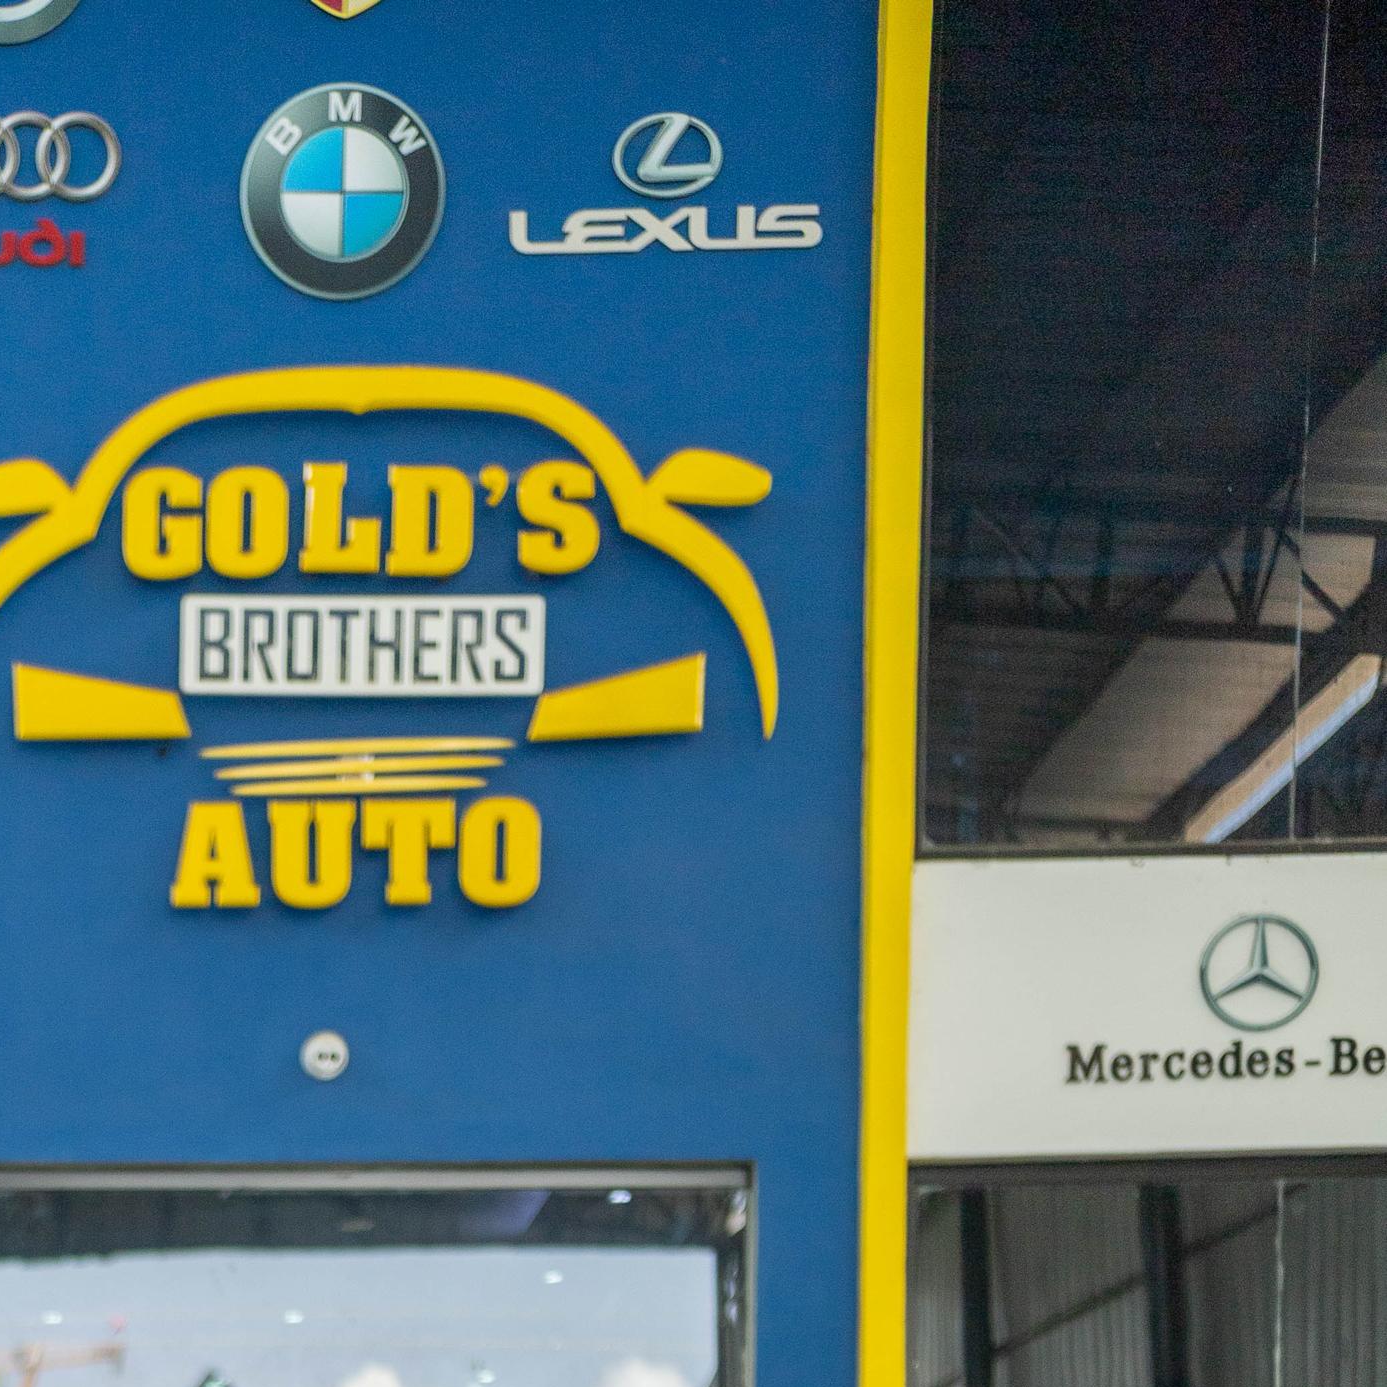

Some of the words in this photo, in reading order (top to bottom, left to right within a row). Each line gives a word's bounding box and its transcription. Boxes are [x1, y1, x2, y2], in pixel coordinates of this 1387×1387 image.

[264, 90, 425, 158] BMW
[508, 204, 823, 256] LEXUS
[122, 460, 602, 582] GOLD'S
[197, 607, 528, 683] BROTHERS
[170, 795, 543, 909] AUTO
